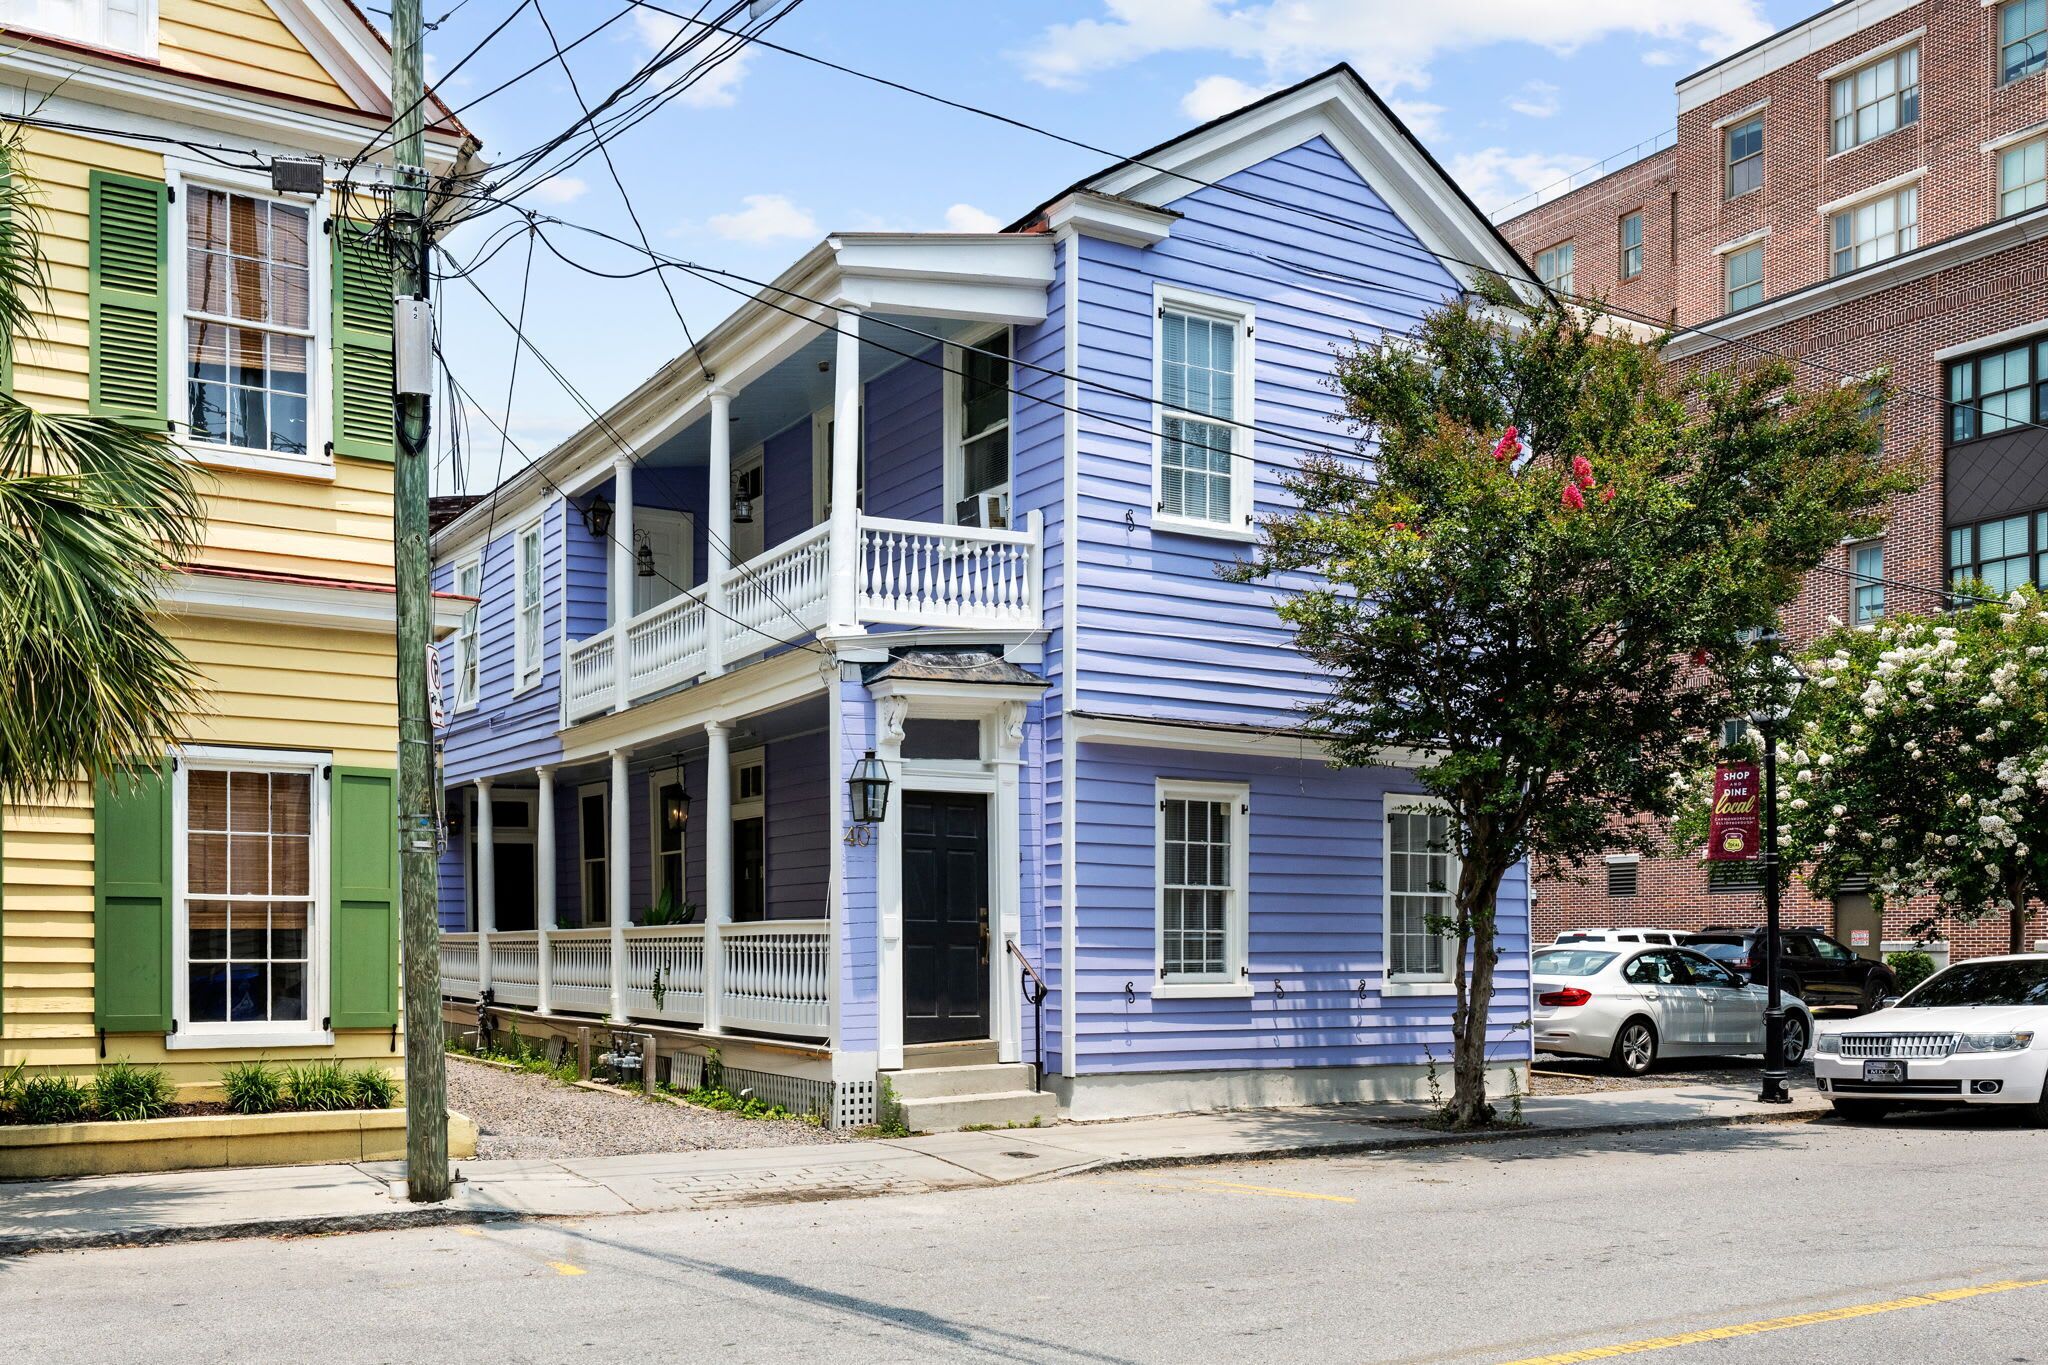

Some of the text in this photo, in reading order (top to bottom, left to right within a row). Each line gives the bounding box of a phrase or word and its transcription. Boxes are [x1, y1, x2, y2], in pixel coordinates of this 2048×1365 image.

[1723, 771, 1750, 781] SHOP
[1724, 787, 1748, 797] DINE
[1715, 794, 1756, 815] local
[843, 825, 871, 847] 40
